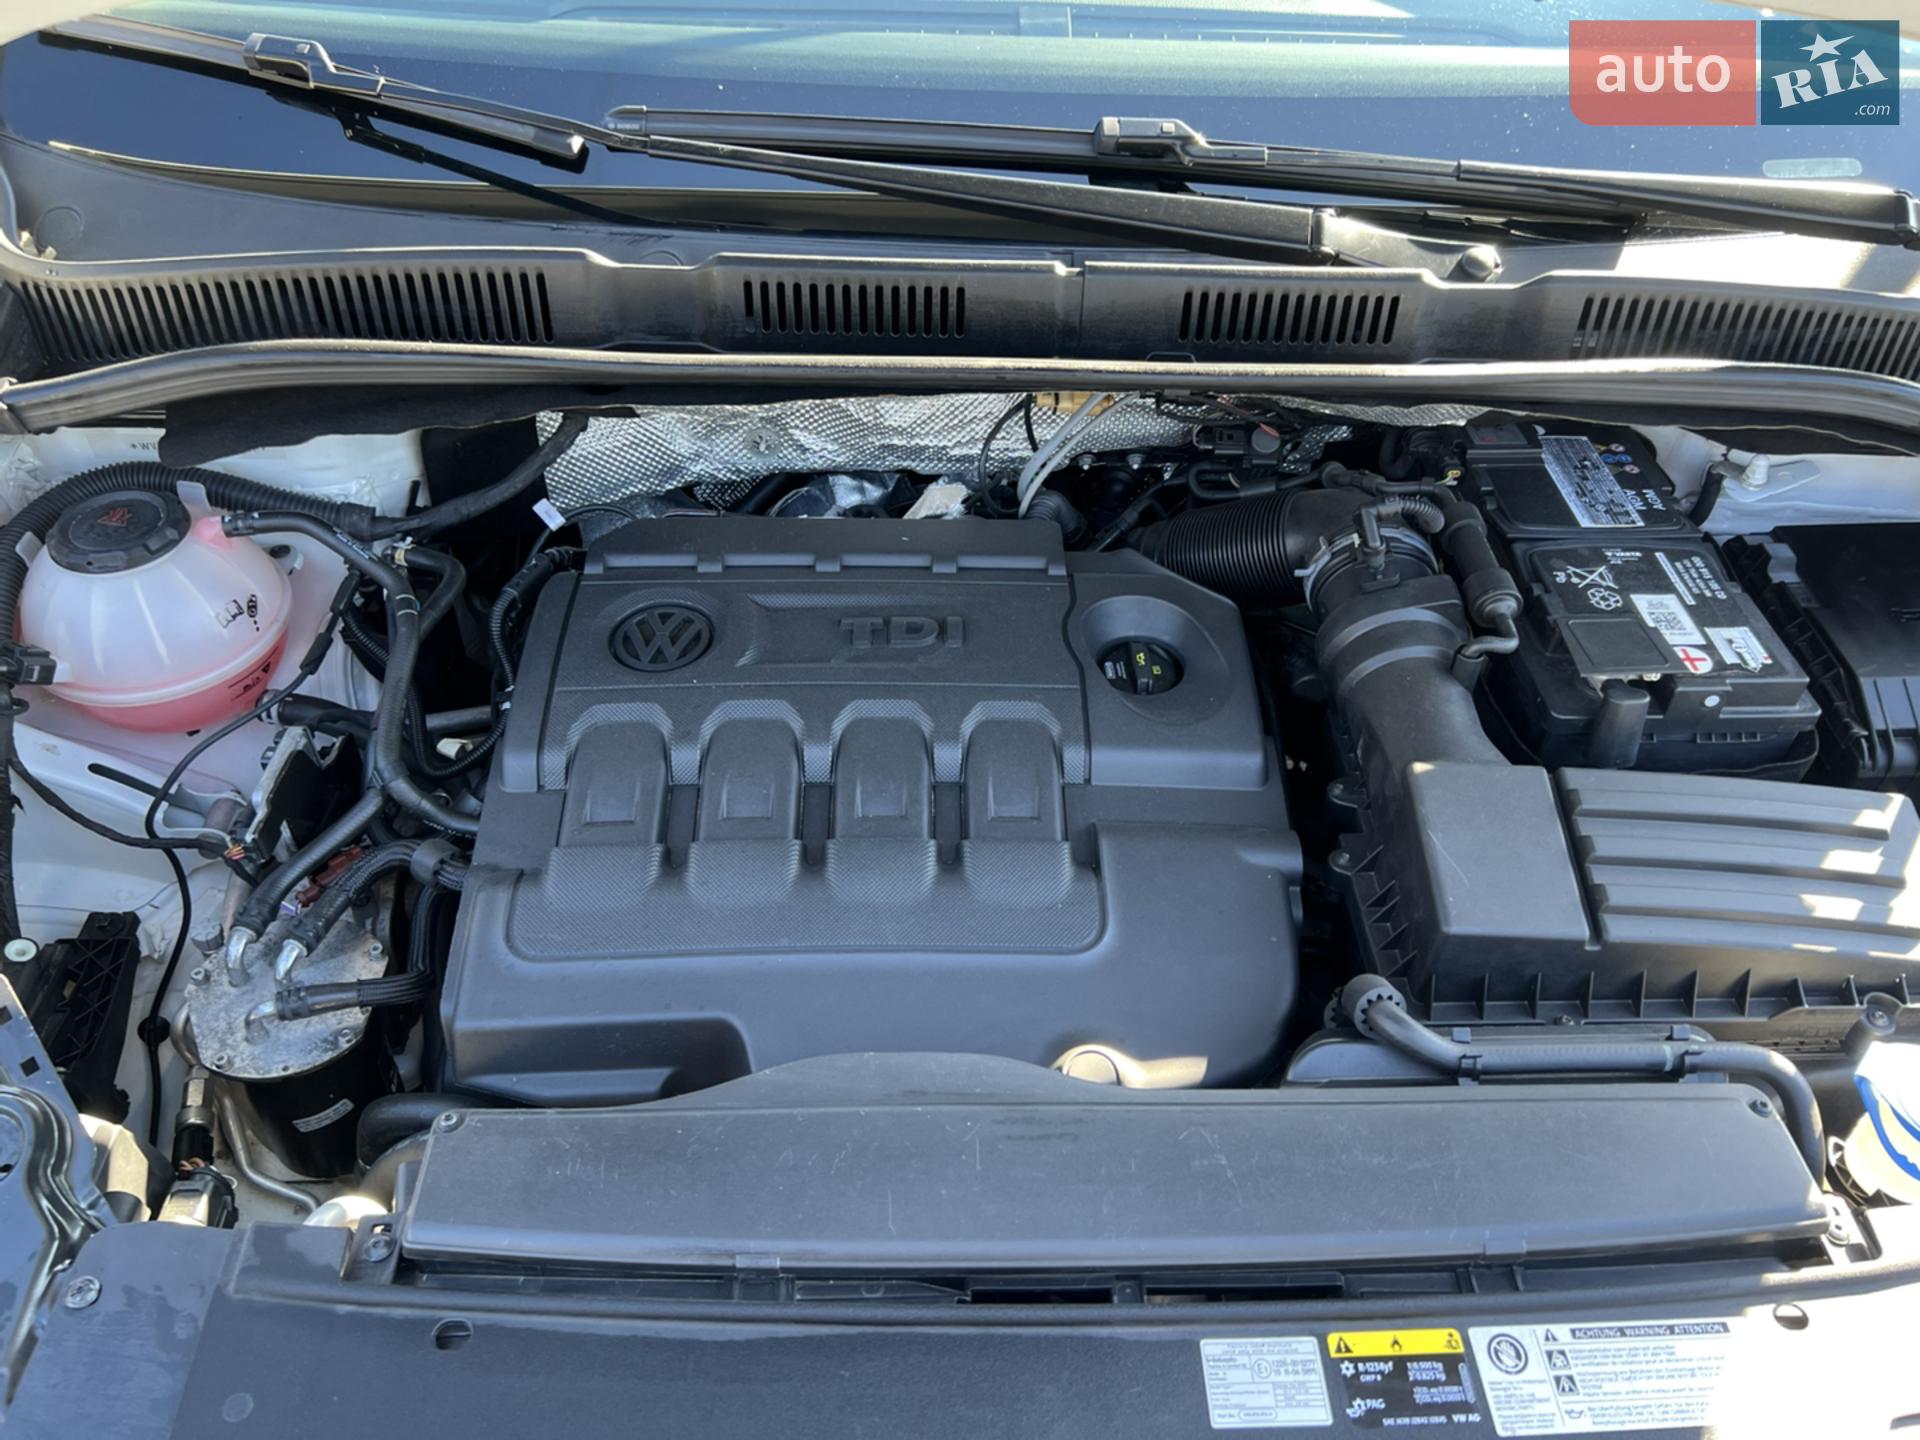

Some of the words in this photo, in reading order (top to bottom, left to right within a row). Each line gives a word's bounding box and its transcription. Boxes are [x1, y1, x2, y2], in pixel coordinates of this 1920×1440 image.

[840, 616, 963, 649] TDI
[1575, 1328, 1621, 1339] ACHTUNG
[1623, 1326, 1670, 1337] WARNING
[1674, 1323, 1723, 1335] ATTENTION
